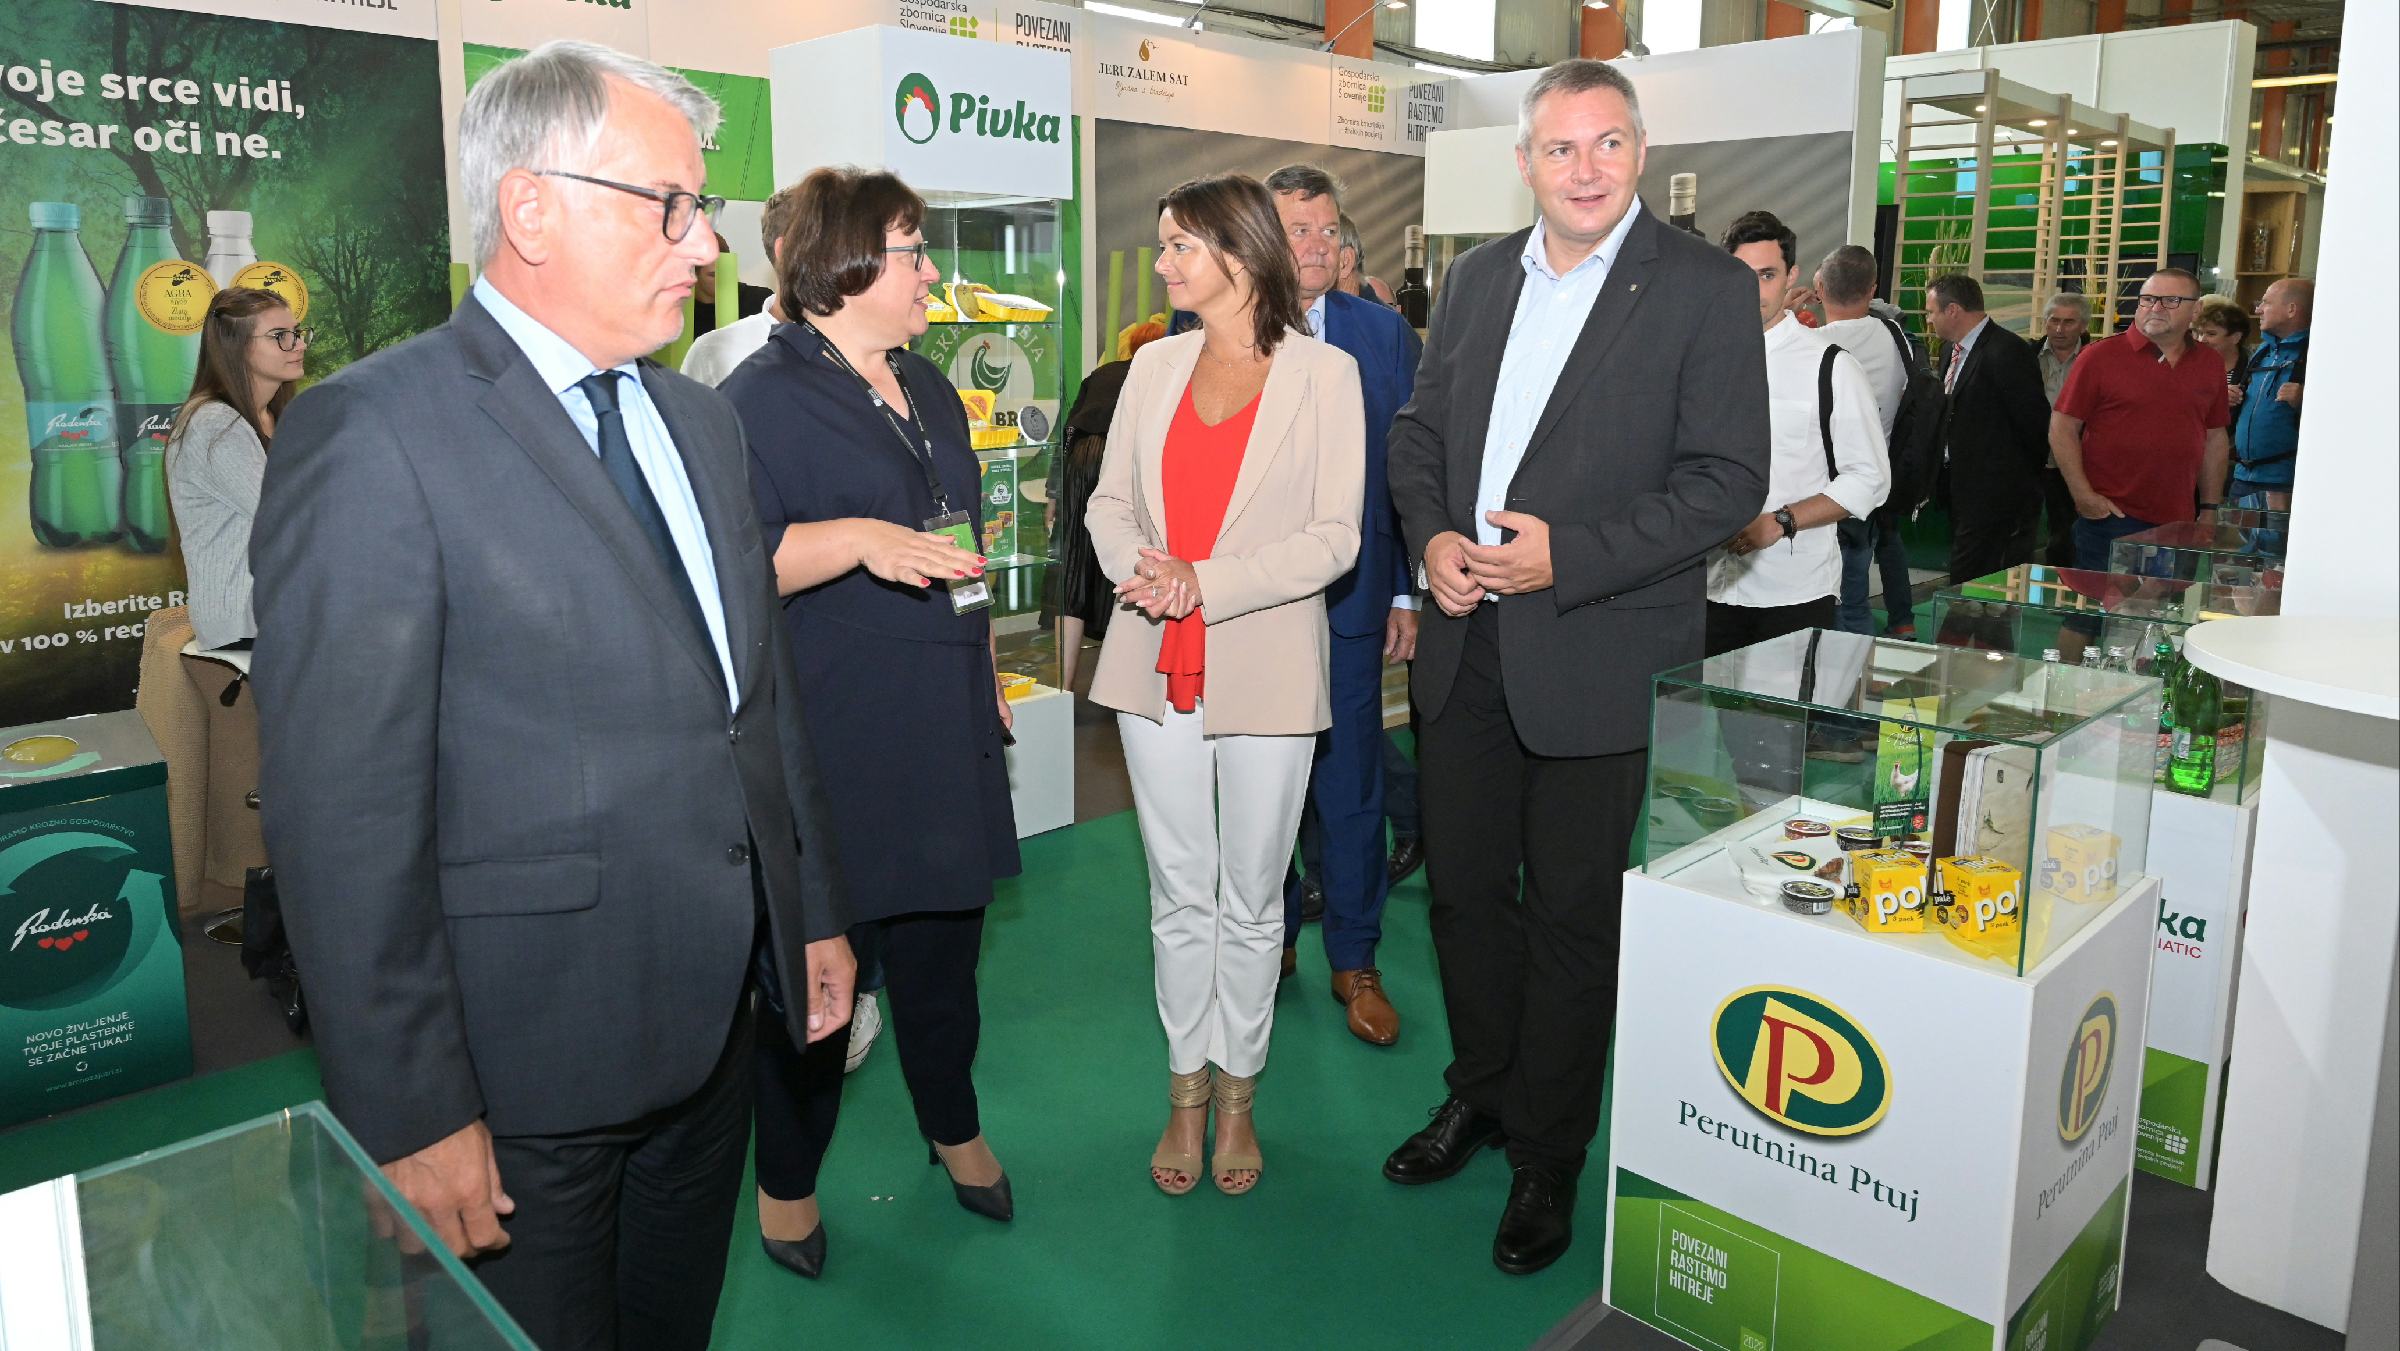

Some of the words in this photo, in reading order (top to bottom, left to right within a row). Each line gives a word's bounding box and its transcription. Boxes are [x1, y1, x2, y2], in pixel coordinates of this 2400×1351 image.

[900, 5, 946, 23] zbornica
[901, 0, 967, 13] spodarska
[1016, 13, 1071, 43] POVEZANI
[0, 59, 86, 102] oje
[100, 73, 200, 105] srce
[212, 77, 305, 119] vidi,
[1099, 63, 1167, 83] JERUZALEM
[1169, 72, 1189, 86] SAT
[1338, 67, 1380, 82] Gospodarska
[1338, 80, 1367, 92] zbornica
[1409, 81, 1444, 103] POVEZANI
[949, 91, 1062, 145] Pivka
[1408, 102, 1444, 124] RASTEMO
[133, 119, 202, 155] oči
[215, 131, 282, 159] ne.
[64, 594, 162, 619] Izberite
[168, 591, 189, 608] R
[0, 639, 14, 654] v
[20, 632, 70, 651] 100
[75, 629, 98, 644] %
[0, 826, 28, 844] RAMO
[69, 818, 135, 838] GOSPODARSTVO
[23, 1039, 63, 1056] TVOJE
[65, 1020, 136, 1047] PLASTENKE
[26, 1028, 63, 1044] NOVO
[66, 1011, 130, 1034] ŽIVLJENJE
[28, 1056, 44, 1067] SE
[46, 1045, 88, 1063] ZAČNE
[89, 1033, 133, 1051] TUKAJ!
[1677, 1099, 1839, 1184] Perutnina
[1848, 1164, 1919, 1223] Ptuj
[2036, 1136, 2095, 1221] Perutnina
[2098, 1106, 2119, 1151] Ptuj
[1671, 1228, 1728, 1270] POVEZANI
[1670, 1248, 1727, 1290] RASTEMO
[1669, 1268, 1714, 1305] HITREJE
[1743, 1334, 1765, 1351] 2022
